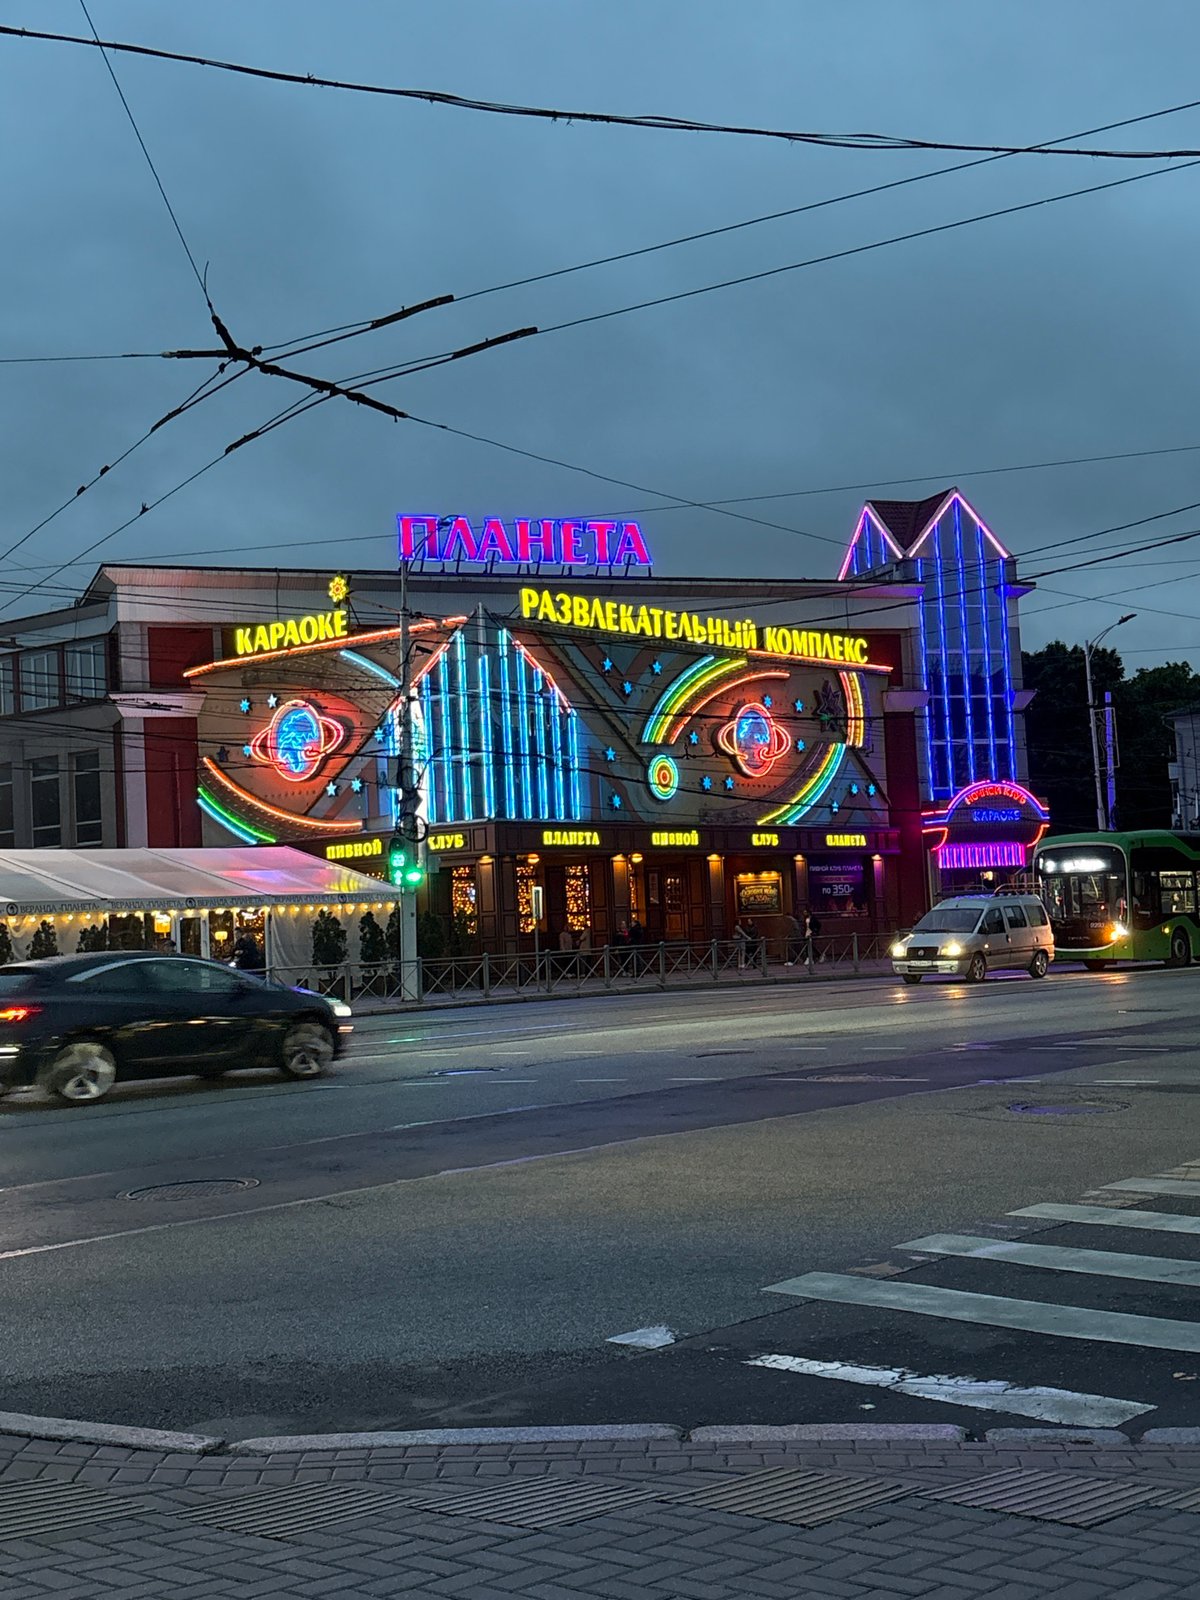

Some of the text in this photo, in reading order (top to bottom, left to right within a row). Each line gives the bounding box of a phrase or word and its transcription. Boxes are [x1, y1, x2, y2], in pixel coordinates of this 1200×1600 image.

[397, 514, 653, 566] ПЛАНЕТА
[236, 610, 348, 655] КАРАОКЕ
[518, 587, 869, 665] РАЗВЛЕКАТЕЛЬНЫЙ КОМПЛЕКС
[326, 833, 464, 860] ПИВНОЙ КЛУБ
[543, 830, 867, 847] ПЛАНЕТА ПИВНОЙ КЛУБ ПЛАНЕТА
[20, 904, 57, 914] ВЕРАНДА
